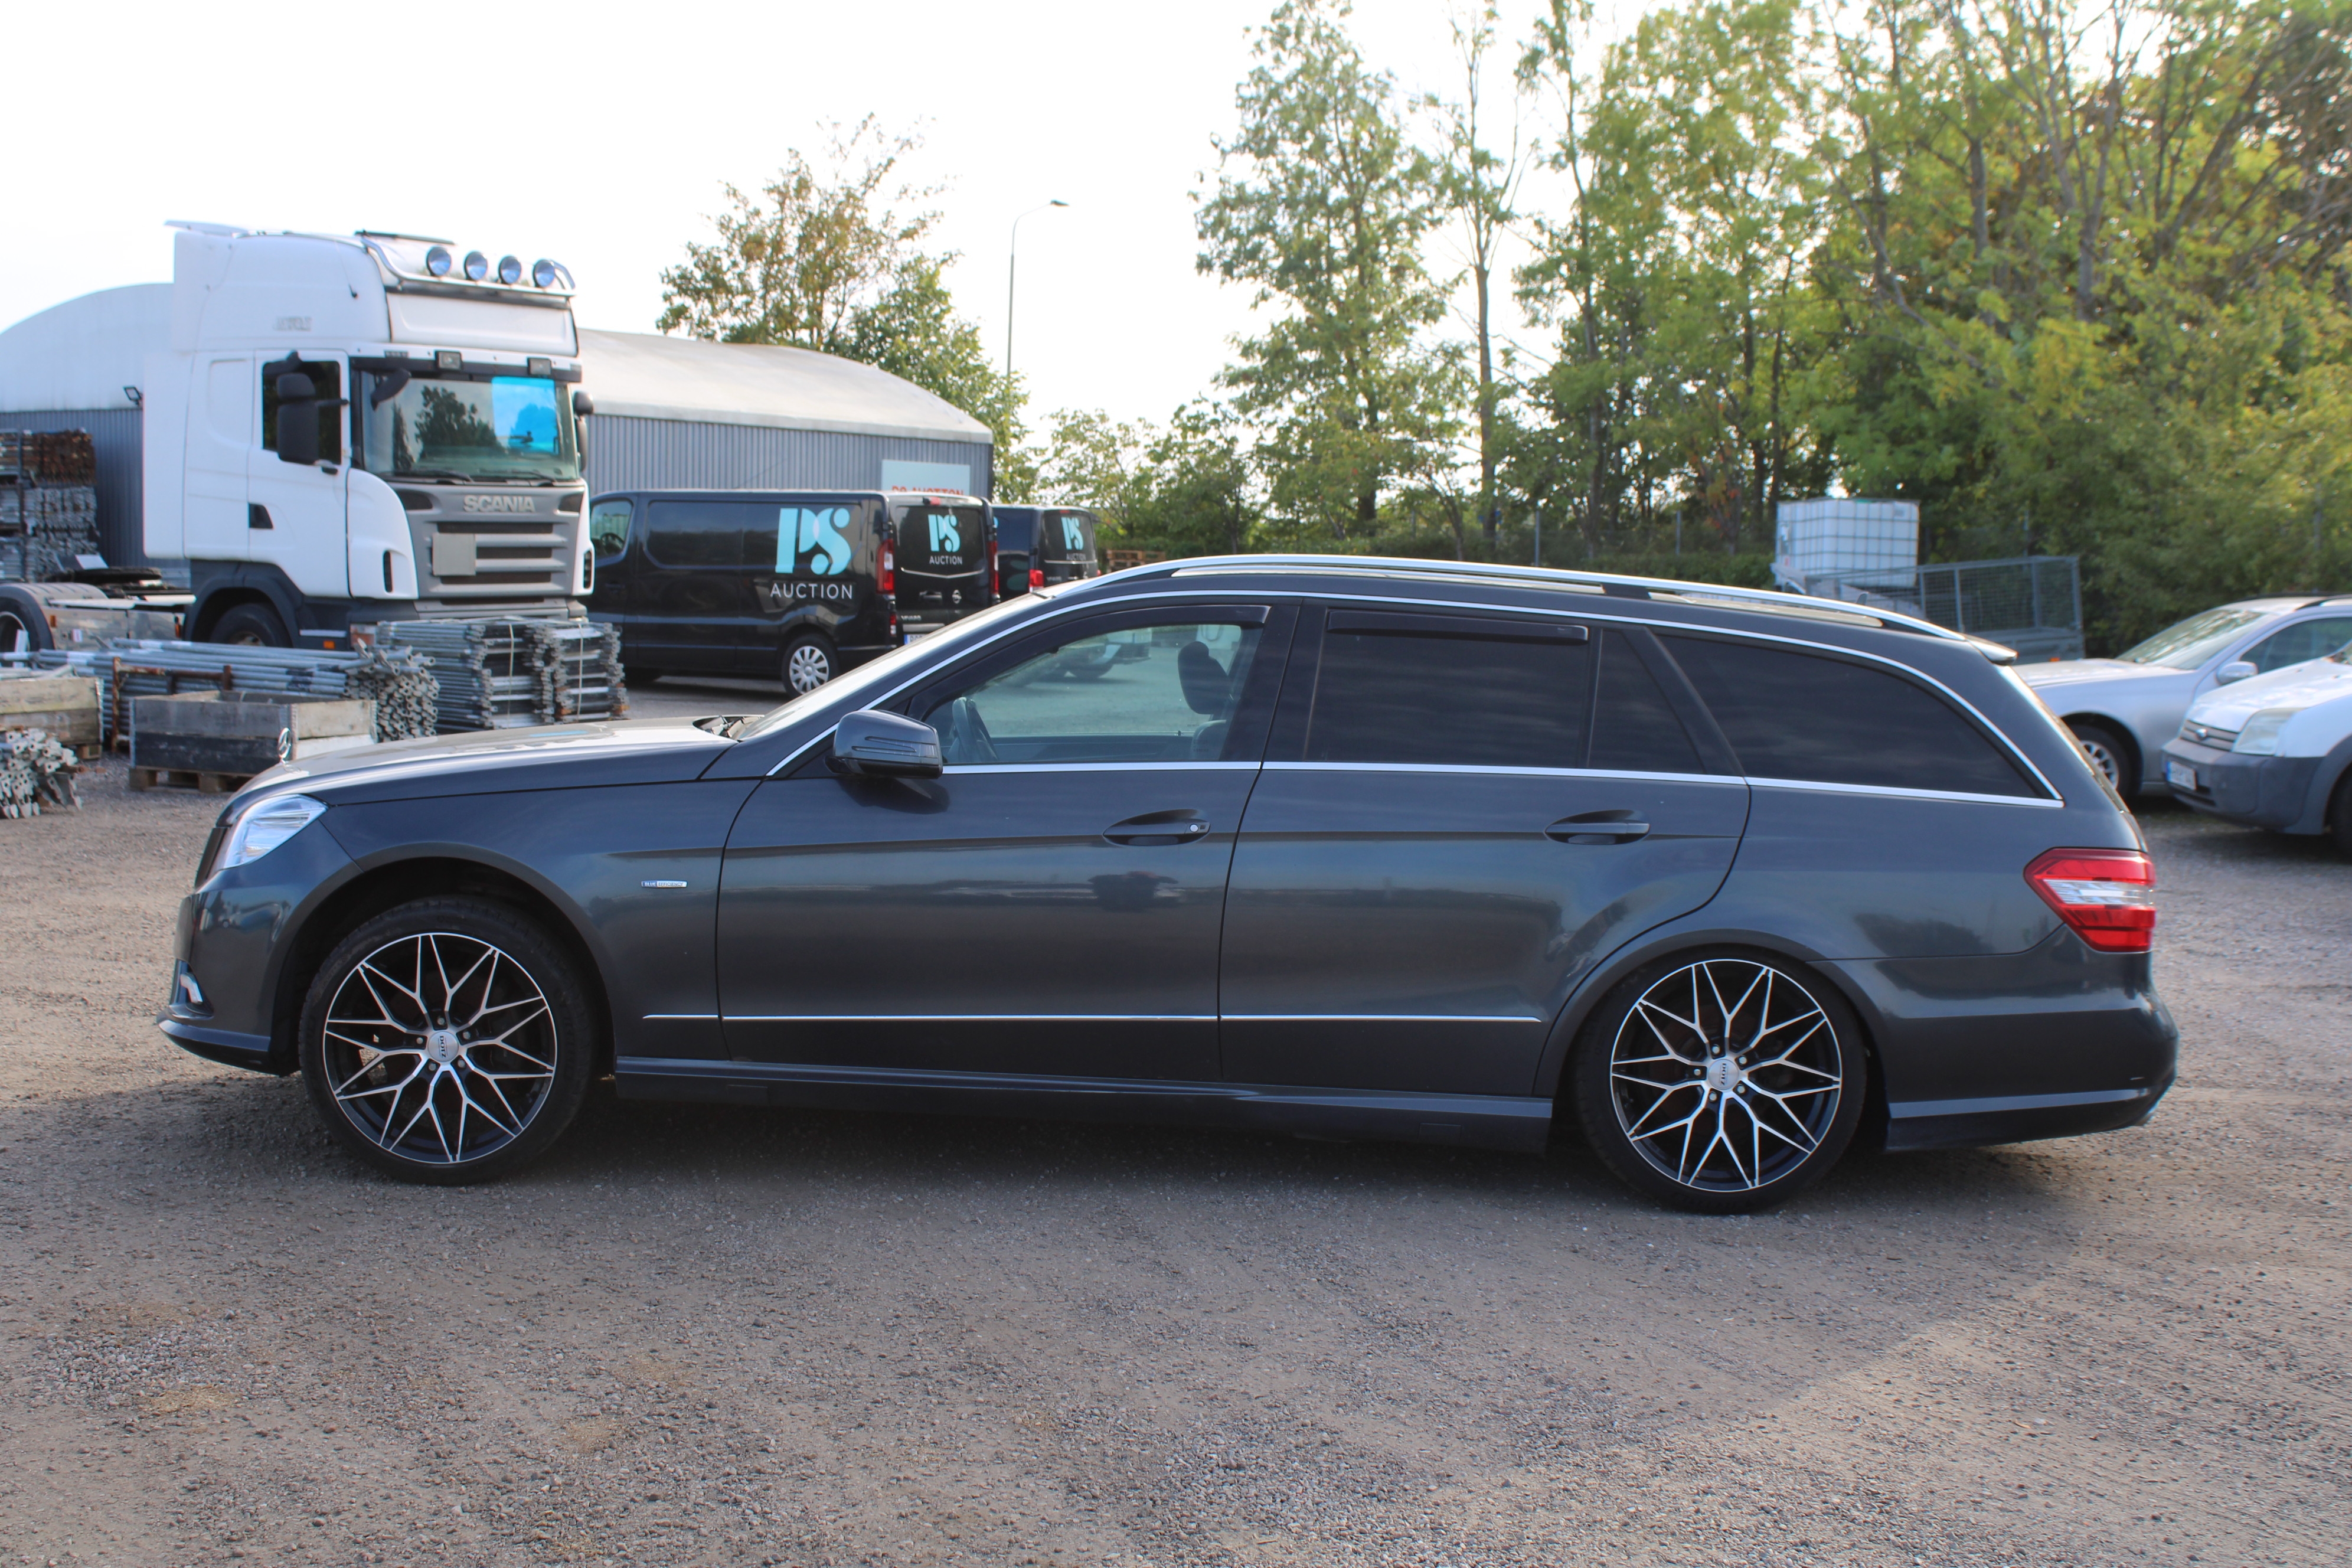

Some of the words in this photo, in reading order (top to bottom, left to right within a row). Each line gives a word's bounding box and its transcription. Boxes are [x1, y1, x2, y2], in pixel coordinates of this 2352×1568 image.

[463, 495, 536, 513] SCANIA
[775, 508, 852, 576] PS
[927, 514, 961, 553] PS
[929, 556, 963, 565] AUCTION
[770, 583, 852, 600] AUCTION
